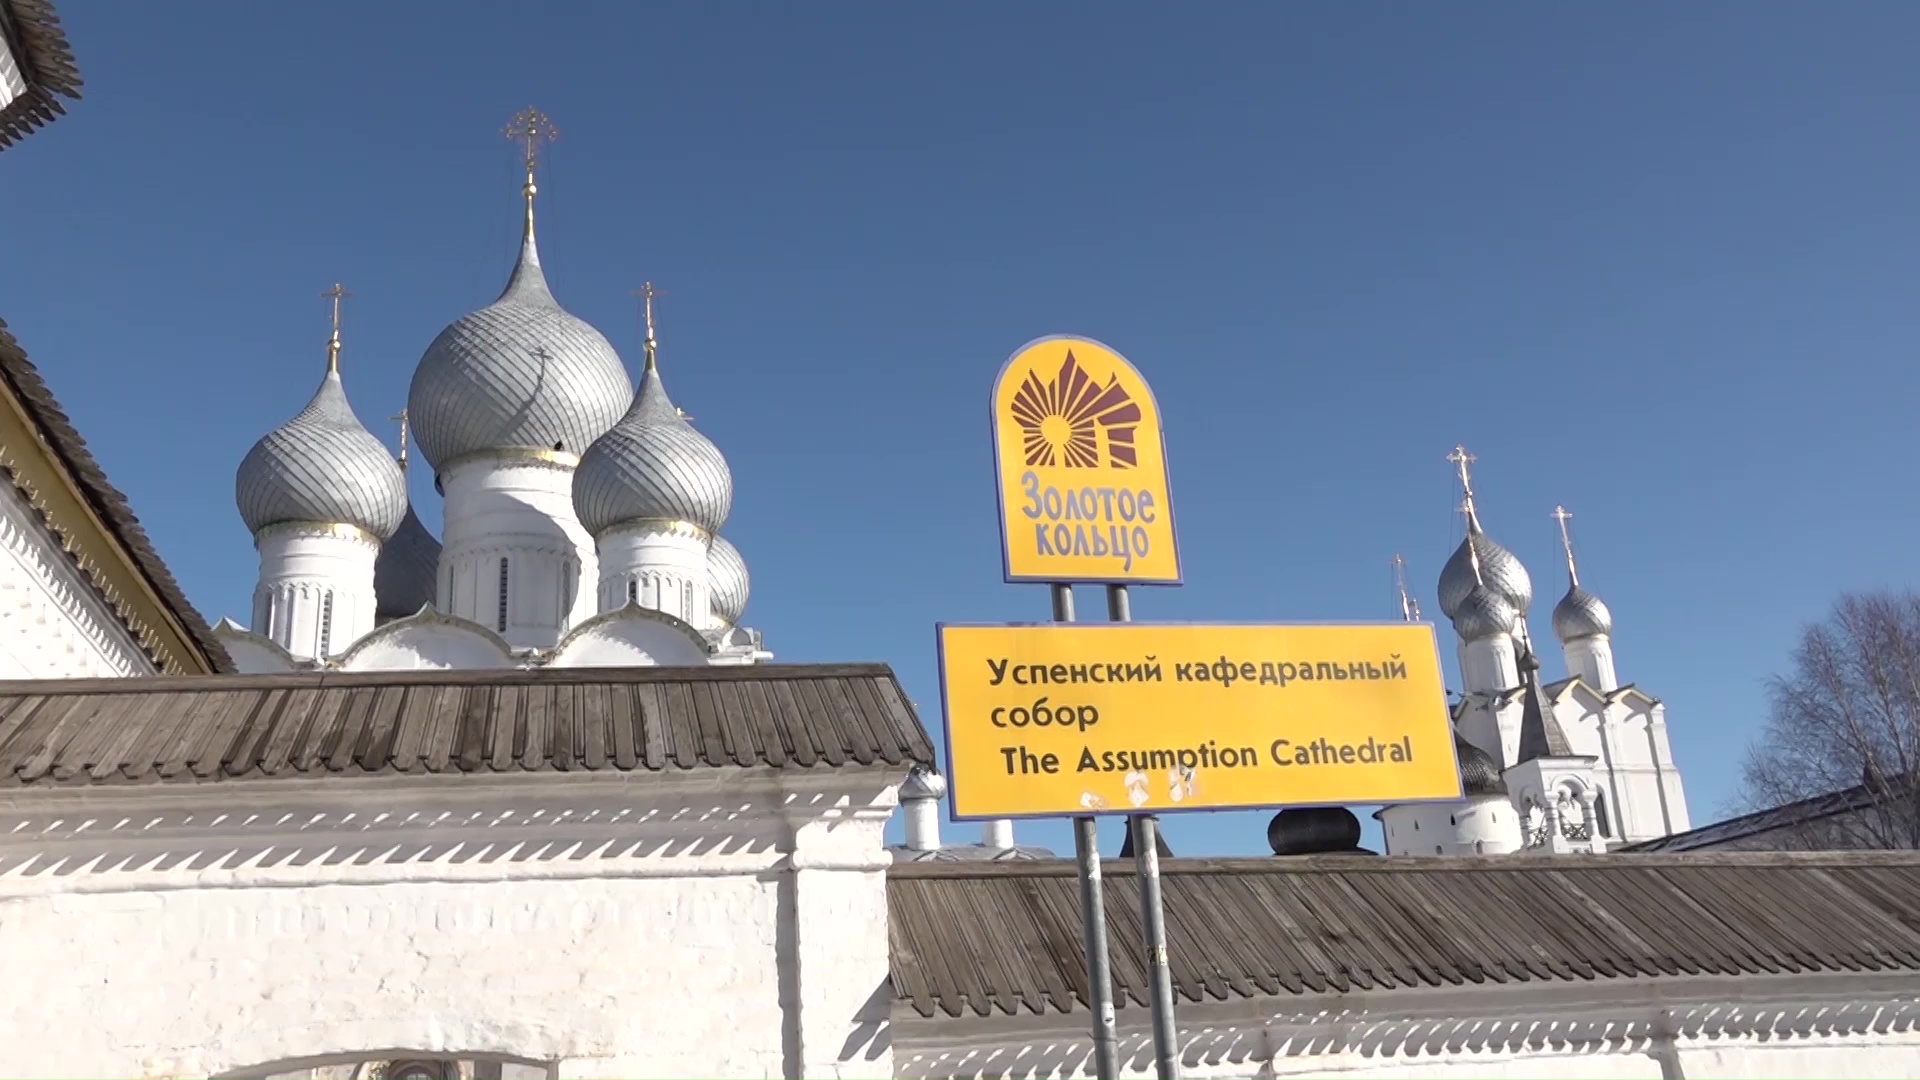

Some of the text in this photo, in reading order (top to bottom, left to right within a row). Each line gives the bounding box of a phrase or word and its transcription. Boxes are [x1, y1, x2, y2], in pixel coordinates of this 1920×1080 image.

[1021, 471, 1156, 524] Золотое
[986, 654, 1407, 688] Успенский кафедральный
[990, 696, 1099, 732] собор
[1000, 736, 1412, 776] The Assumption Cathedral
